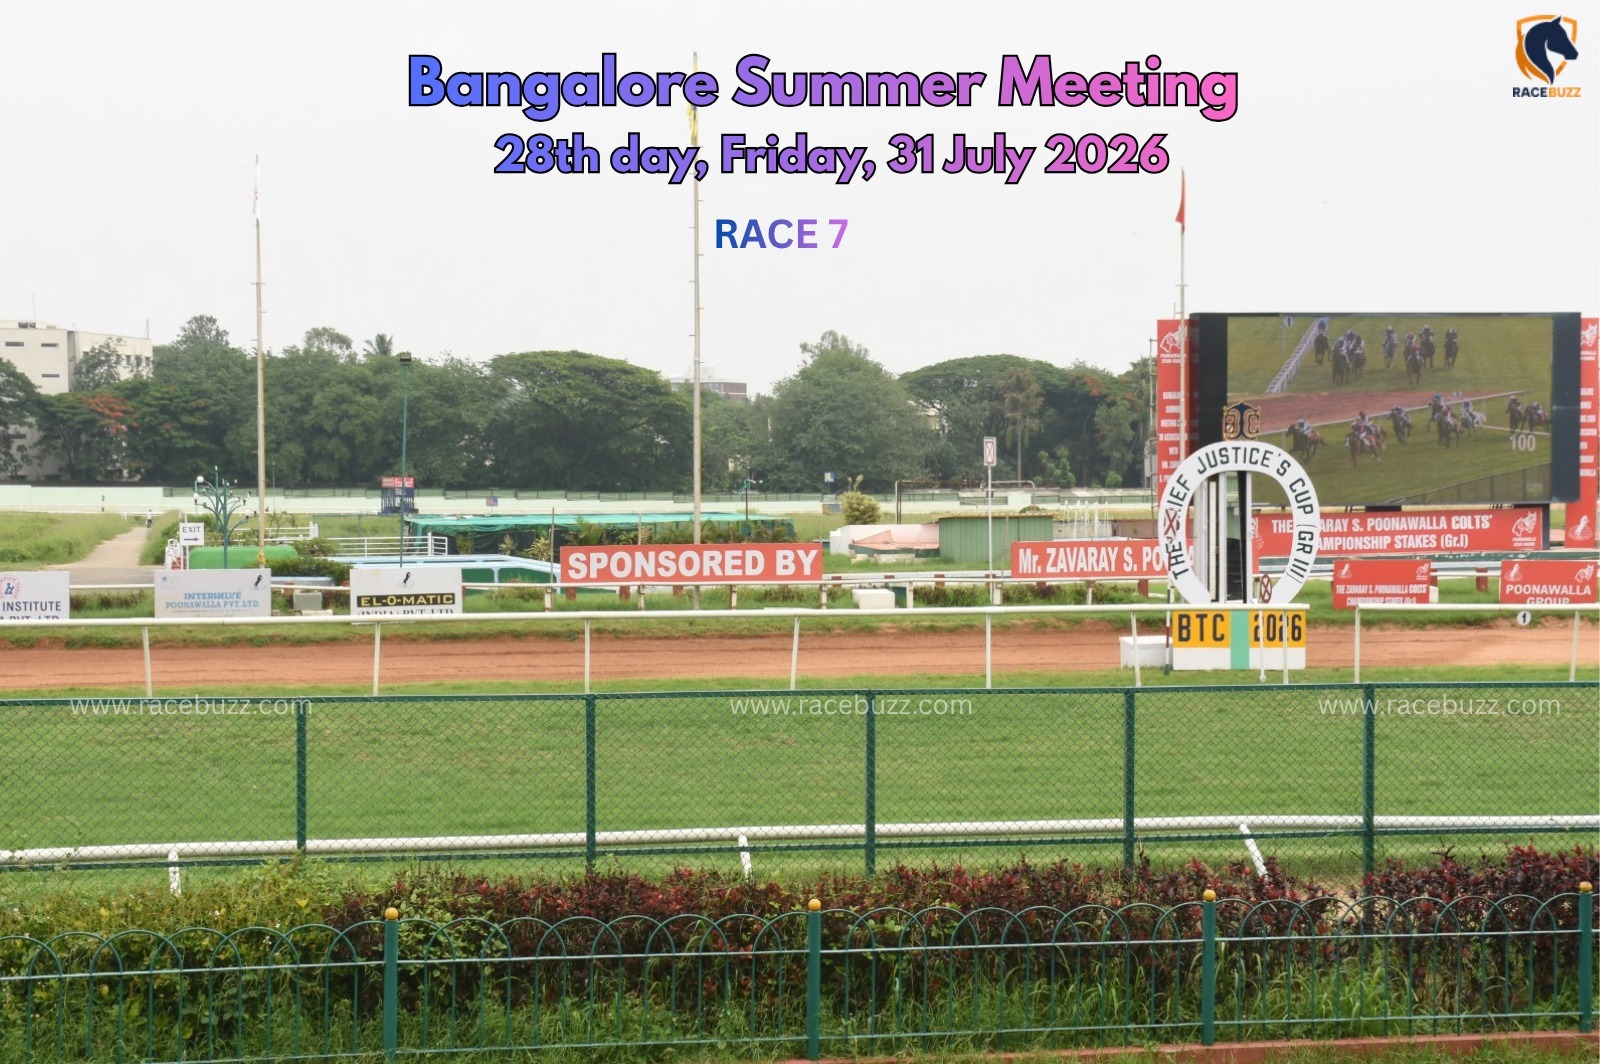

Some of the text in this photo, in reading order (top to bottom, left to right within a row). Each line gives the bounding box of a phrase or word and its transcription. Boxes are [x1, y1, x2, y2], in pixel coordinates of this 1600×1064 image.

[1511, 435, 1535, 451] 100
[1197, 447, 1291, 476] JUSTICE'S
[1289, 477, 1314, 515] CUP
[1272, 519, 1293, 533] THE
[1352, 518, 1363, 531] S.
[1367, 516, 1447, 531] POONAWALLA
[1451, 515, 1493, 530] COLTS'
[1296, 524, 1317, 555] (GR
[1318, 536, 1391, 550] AMPIONSHIP
[1394, 534, 1437, 549] STAKES
[568, 550, 818, 580] SPONSORED BY
[1018, 548, 1041, 573] Mr.
[1046, 547, 1118, 573] ZAVARAY
[1123, 547, 1137, 572] S.
[1286, 558, 1309, 583] III)
[1506, 585, 1592, 595] POONAWALLA
[3, 601, 61, 611] INSTITUTE
[166, 601, 221, 609] POONAWALLA
[361, 595, 453, 607] EL-O-MATIC
[1522, 613, 1526, 623] 1
[1178, 614, 1225, 642] BTC
